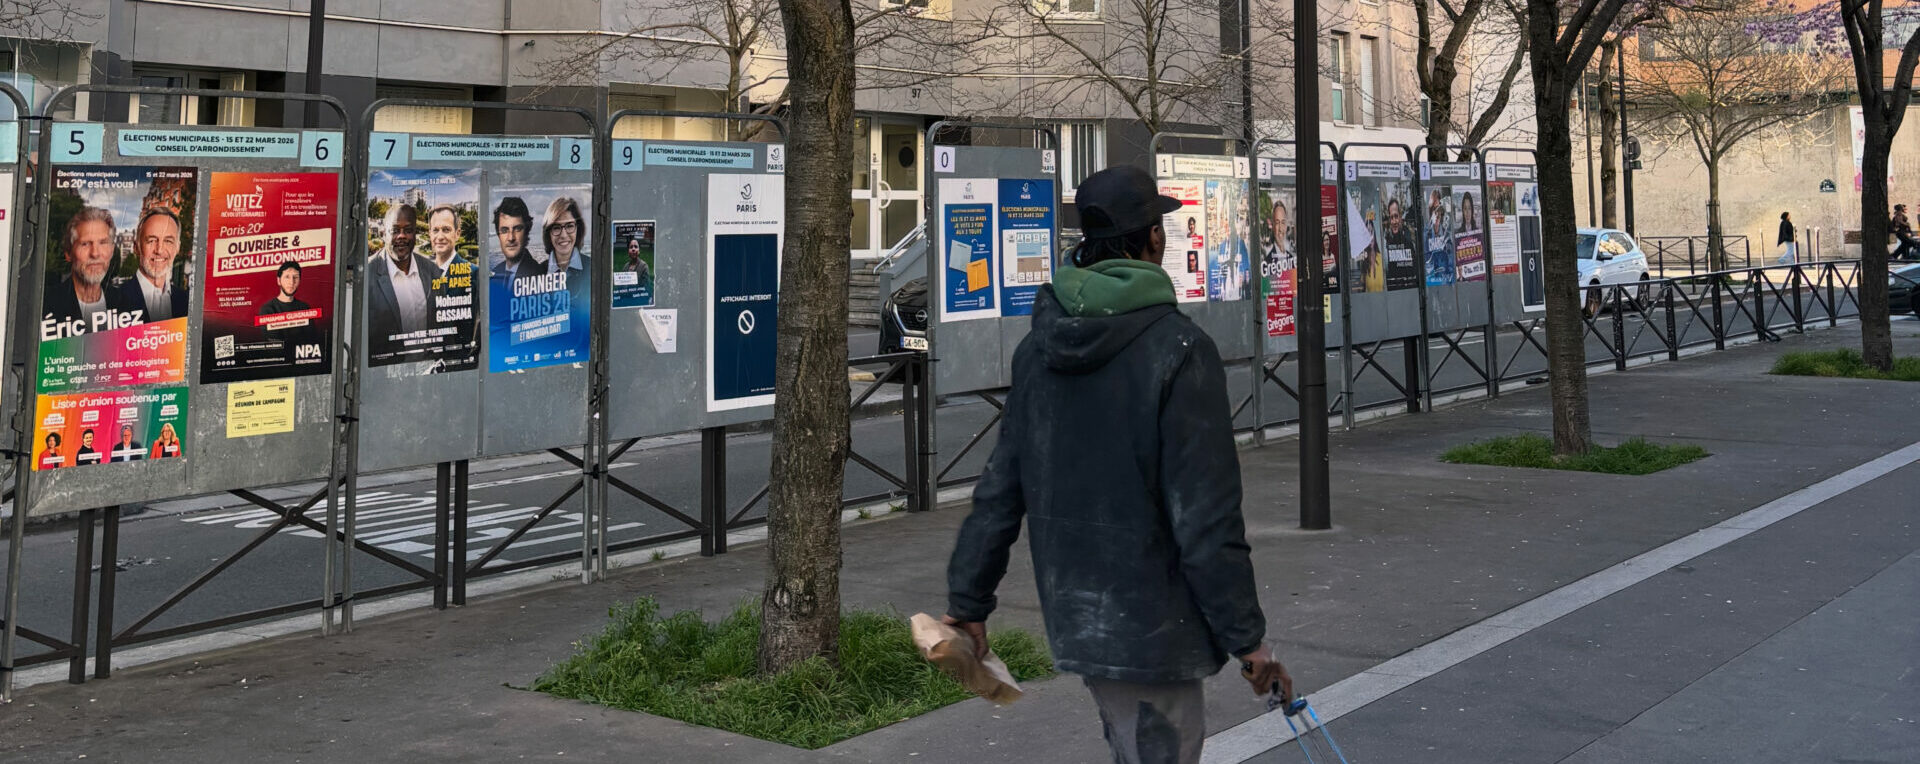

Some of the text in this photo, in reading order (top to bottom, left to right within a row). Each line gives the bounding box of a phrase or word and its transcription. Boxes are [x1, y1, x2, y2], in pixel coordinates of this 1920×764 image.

[912, 88, 921, 98] 97
[68, 130, 85, 155] 5
[315, 138, 328, 160] 6
[384, 139, 396, 161] 7
[570, 144, 581, 164] 8
[623, 146, 632, 166] 9
[942, 152, 948, 168] 0
[1162, 158, 1168, 172] 1
[1239, 162, 1244, 175] 2
[1262, 162, 1266, 175] 3
[1329, 164, 1333, 175] 4
[1348, 165, 1353, 178] 5
[1403, 165, 1408, 177] 6
[1423, 165, 1427, 177] 7
[1473, 166, 1477, 177] 8
[1489, 166, 1492, 178] 9
[57, 179, 69, 188] Le
[88, 180, 103, 188] est
[104, 179, 110, 188] à
[226, 194, 263, 209] VOTEZ
[736, 204, 757, 213] PARIS
[220, 224, 245, 237] Paris
[228, 235, 300, 254] OUVRIÈRE &
[221, 248, 322, 270] RÉVOLUTIONNAIRE
[449, 262, 471, 275] PARIS
[1261, 256, 1297, 278] Grégoire
[449, 275, 471, 288] APAISÉ
[513, 272, 567, 297] CHANGER
[435, 293, 472, 308] Mohamad
[510, 290, 570, 320] PARIS 20
[259, 310, 318, 324] BENJAMIN GUIGNARD
[436, 307, 472, 322] GASSAMA
[41, 308, 144, 342] Éric Pliez
[549, 324, 561, 334] DATI
[1267, 314, 1294, 331] Grégoire
[126, 331, 183, 351] Grégoire
[295, 344, 321, 359] NPA
[44, 356, 74, 365] L'union
[44, 365, 55, 374] de
[67, 363, 96, 374] gauche
[99, 362, 106, 370] et
[109, 360, 123, 369] des
[125, 357, 169, 370] écologistes
[52, 392, 177, 409] Liste d'union soutenue par
